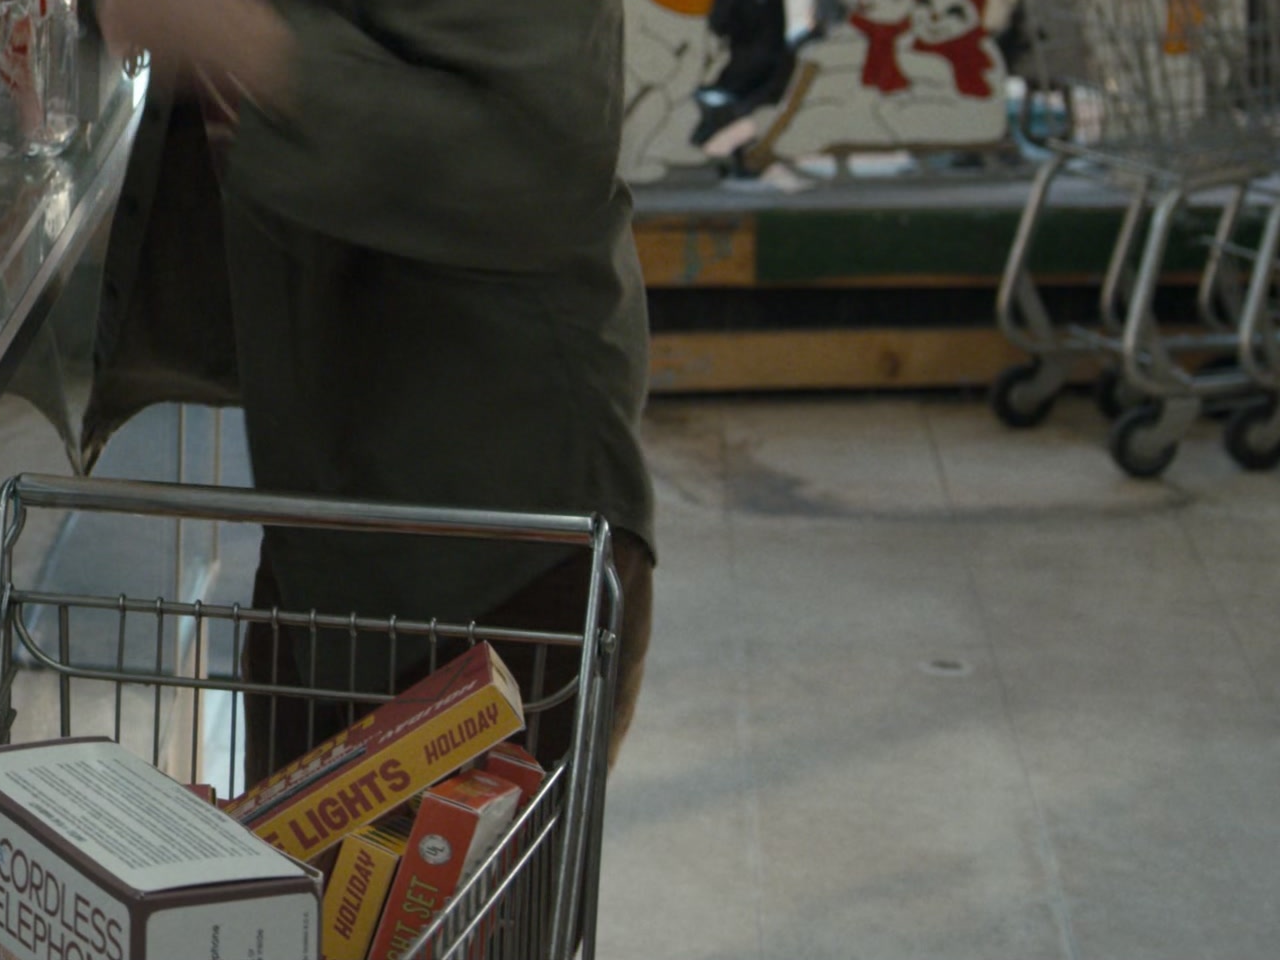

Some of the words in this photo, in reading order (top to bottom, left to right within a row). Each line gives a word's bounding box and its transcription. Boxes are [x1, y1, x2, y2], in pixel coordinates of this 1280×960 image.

[287, 757, 412, 851] LIGHTS
[422, 702, 499, 766] HOLIDAY
[333, 847, 377, 941] HOLIDAY
[402, 874, 439, 920] SET
